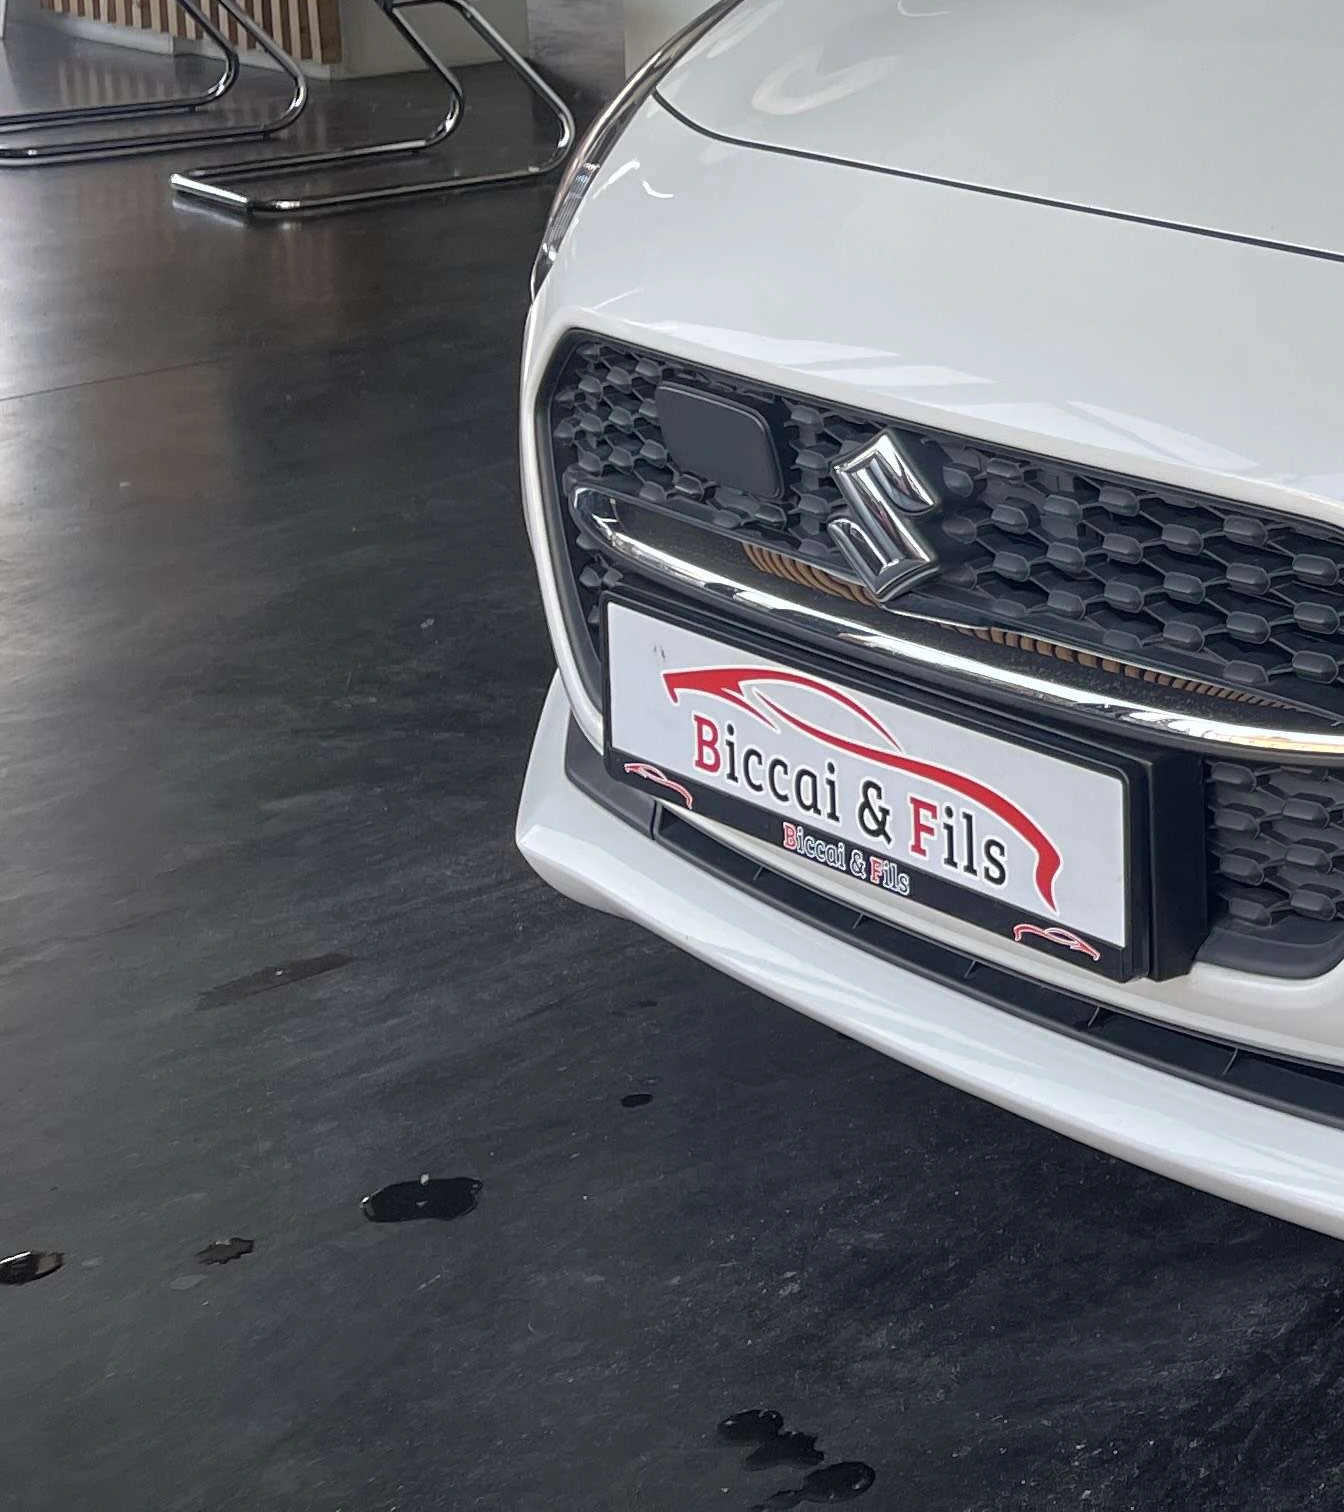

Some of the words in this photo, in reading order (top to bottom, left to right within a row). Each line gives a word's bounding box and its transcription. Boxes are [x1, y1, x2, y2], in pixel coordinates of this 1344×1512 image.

[693, 713, 838, 824] Biccai
[857, 780, 893, 844] &
[909, 796, 1007, 887] Fils
[783, 821, 845, 873] Biccai
[850, 848, 866, 876] &
[870, 856, 910, 896] Fils
